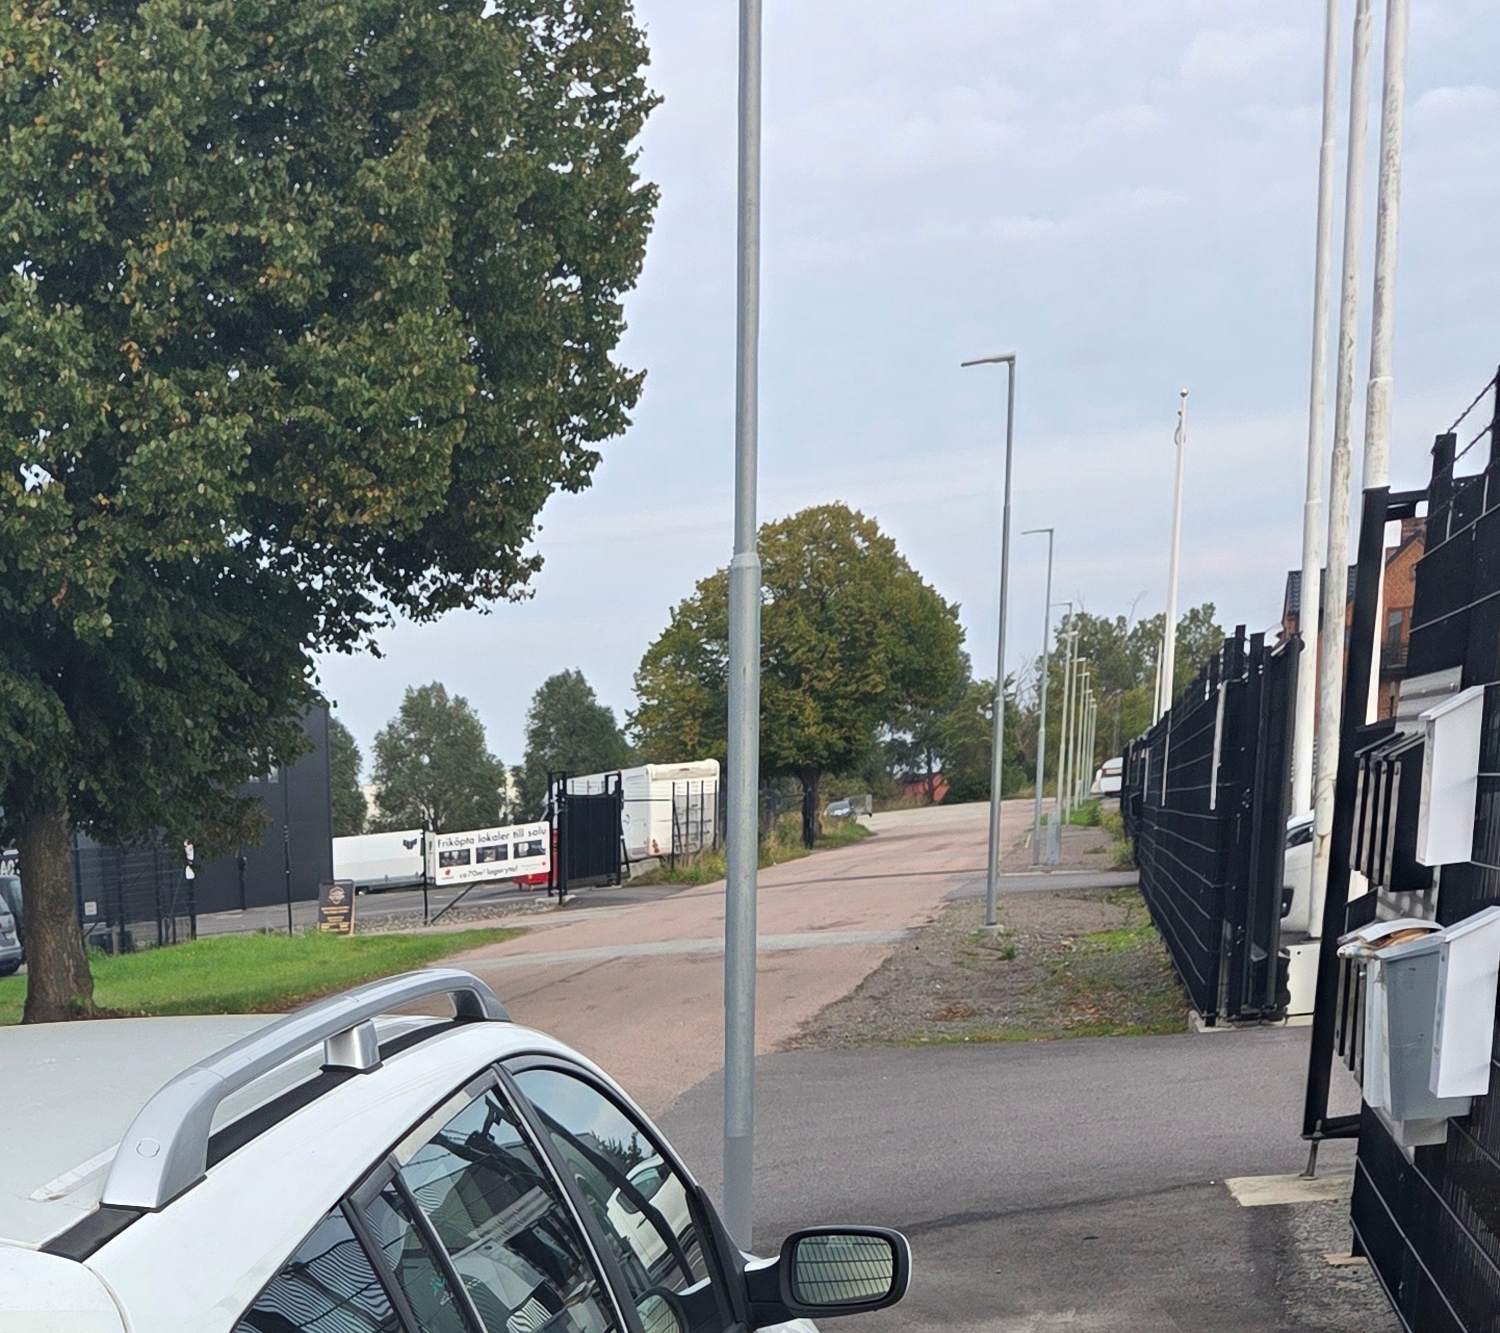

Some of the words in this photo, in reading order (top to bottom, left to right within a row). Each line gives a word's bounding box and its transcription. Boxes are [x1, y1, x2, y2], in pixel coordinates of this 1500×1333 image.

[437, 837, 475, 849] Friköpta
[478, 831, 510, 843] lokaler
[513, 828, 524, 839] till
[528, 826, 547, 837] salu
